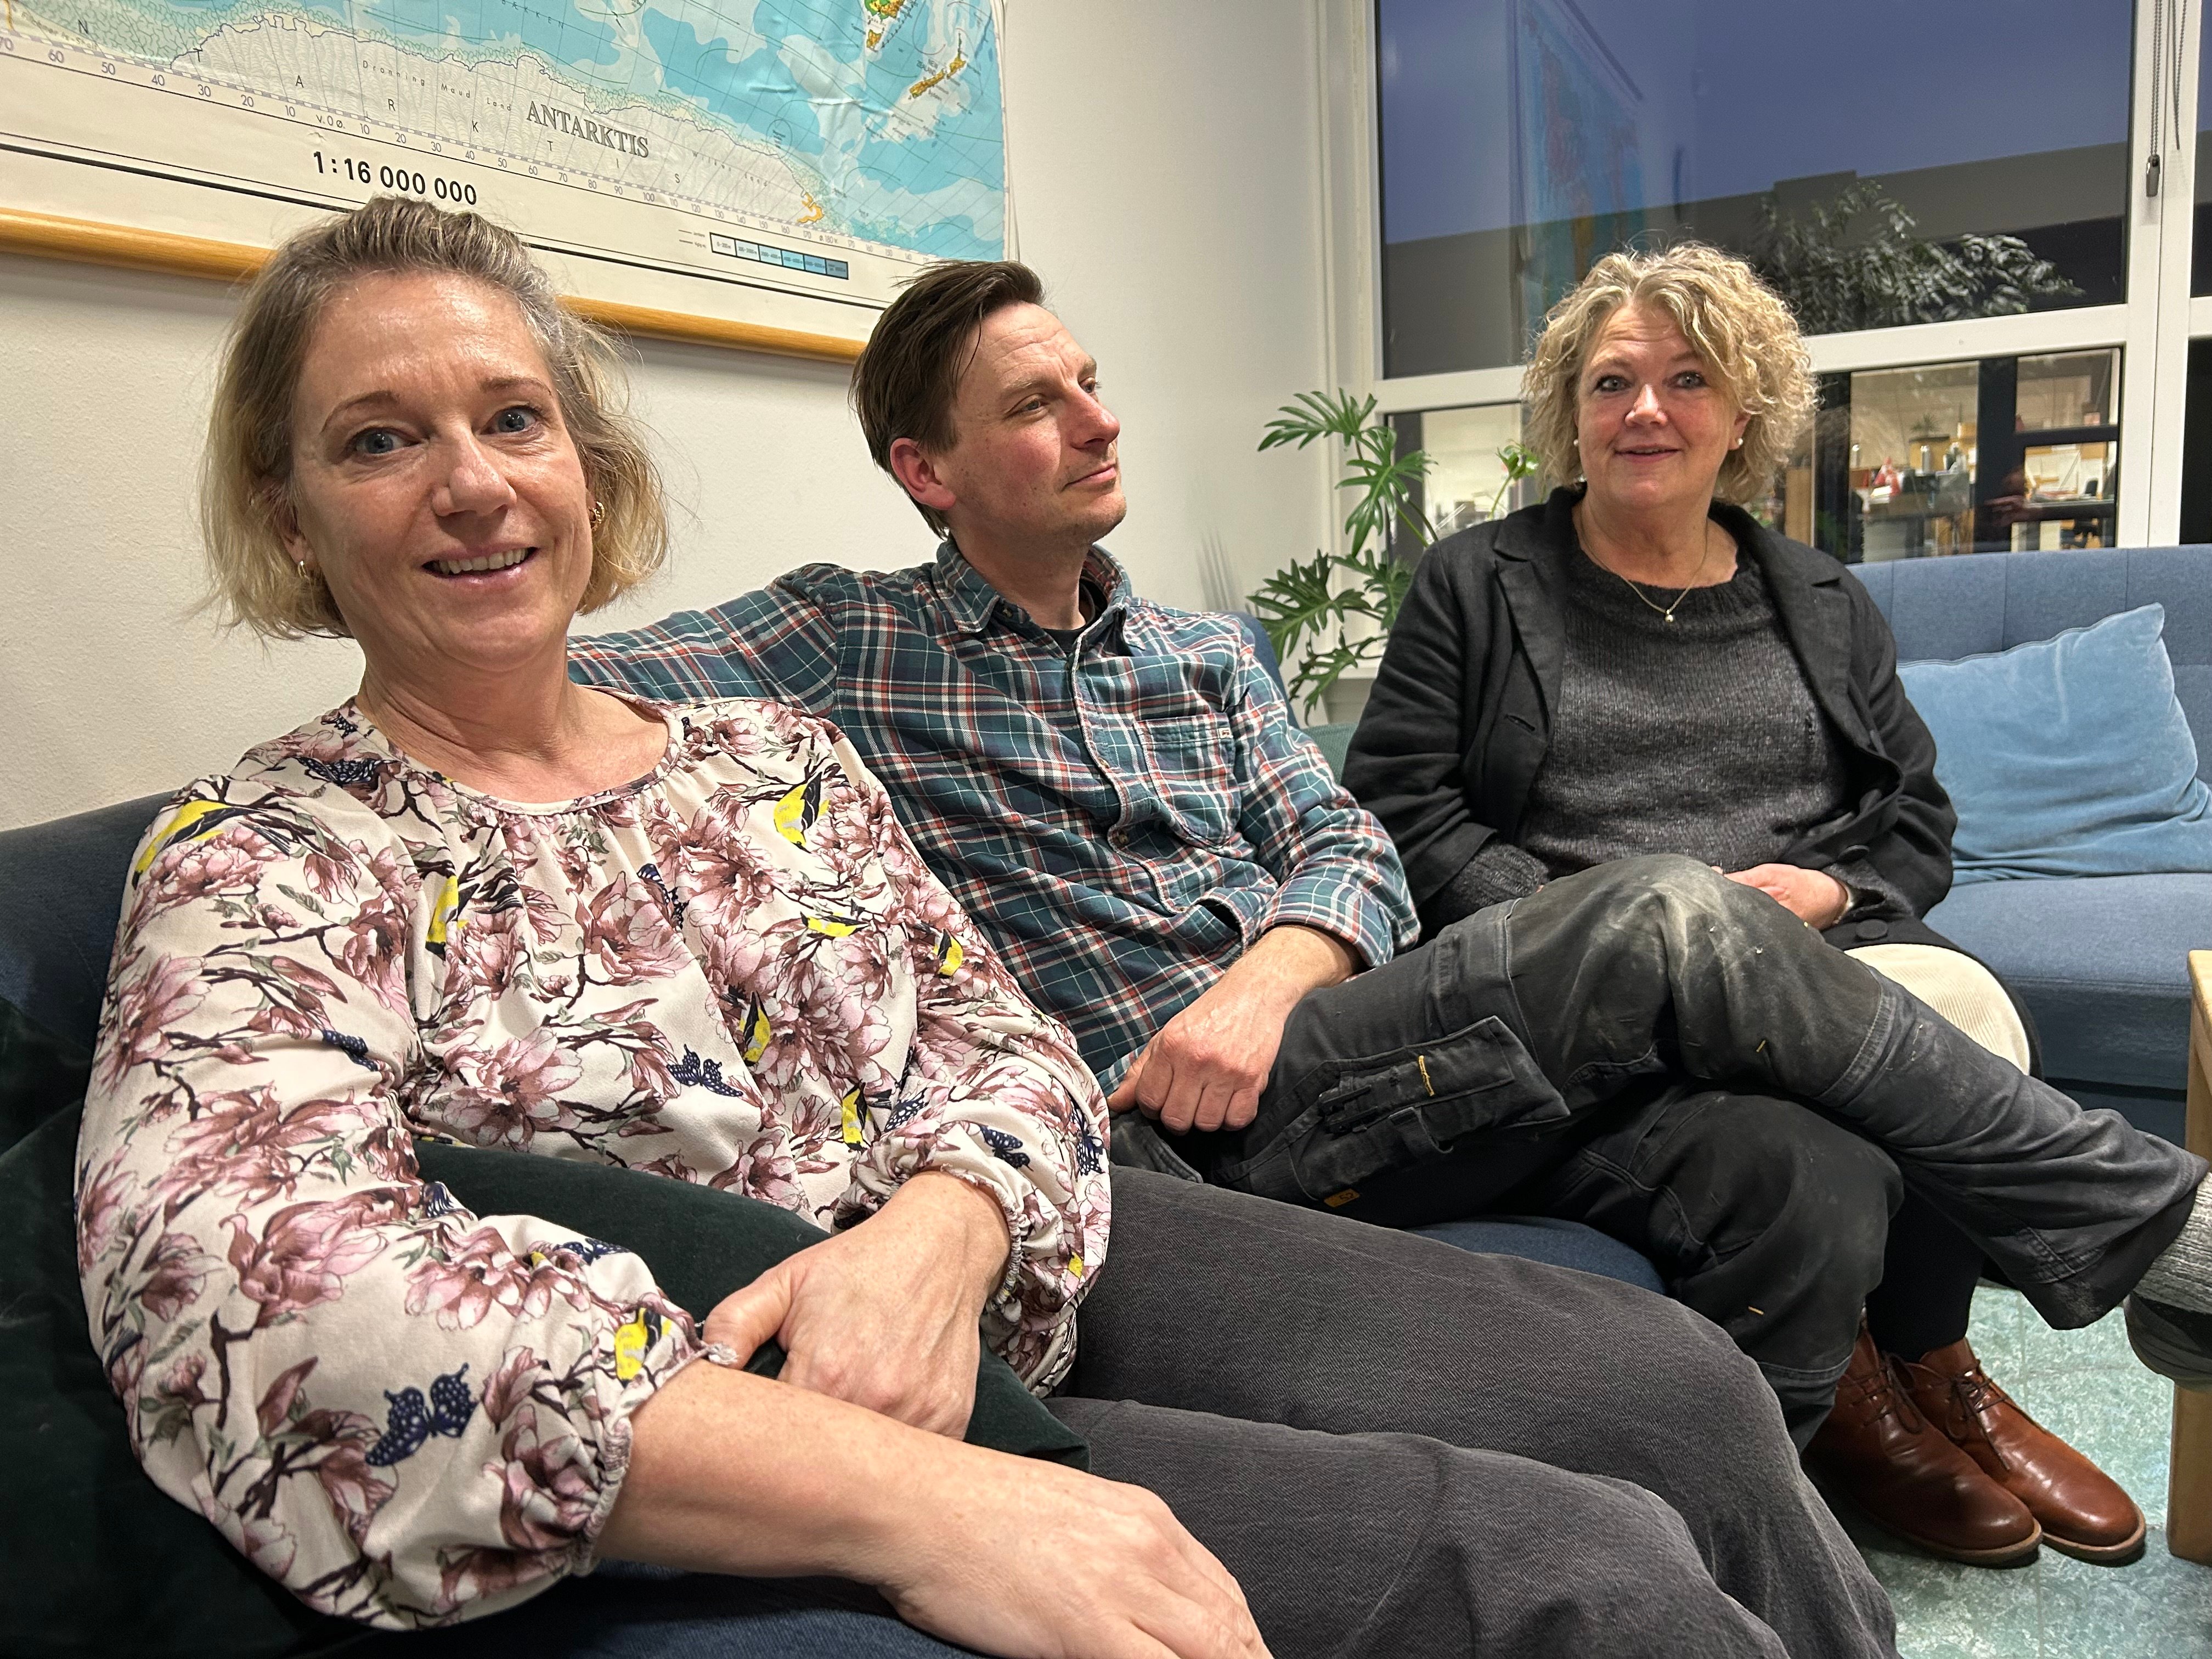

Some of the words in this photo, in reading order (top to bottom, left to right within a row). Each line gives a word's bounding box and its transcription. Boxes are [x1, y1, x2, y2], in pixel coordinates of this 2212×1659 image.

[363, 60, 425, 86] Dronning
[441, 83, 470, 98] Maud
[487, 98, 511, 111] Land
[48, 48, 64, 64] 60
[101, 61, 116, 75] 50
[151, 74, 165, 86] 40
[198, 84, 211, 97] 30
[241, 94, 254, 107] 20
[285, 105, 296, 117] 10
[360, 123, 370, 135] 10
[395, 132, 407, 144] 20
[431, 142, 442, 153] 30
[465, 150, 475, 160] 40
[498, 159, 507, 168] 50
[528, 165, 538, 176] 60
[558, 172, 568, 183] 70
[588, 179, 597, 189] 80
[614, 185, 623, 195] 90
[642, 192, 655, 202] 100
[691, 203, 701, 213] 120
[527, 100, 649, 158] ANTARKTIS
[313, 151, 371, 184] 1:16
[380, 165, 426, 195] 000
[434, 177, 477, 205] 000
